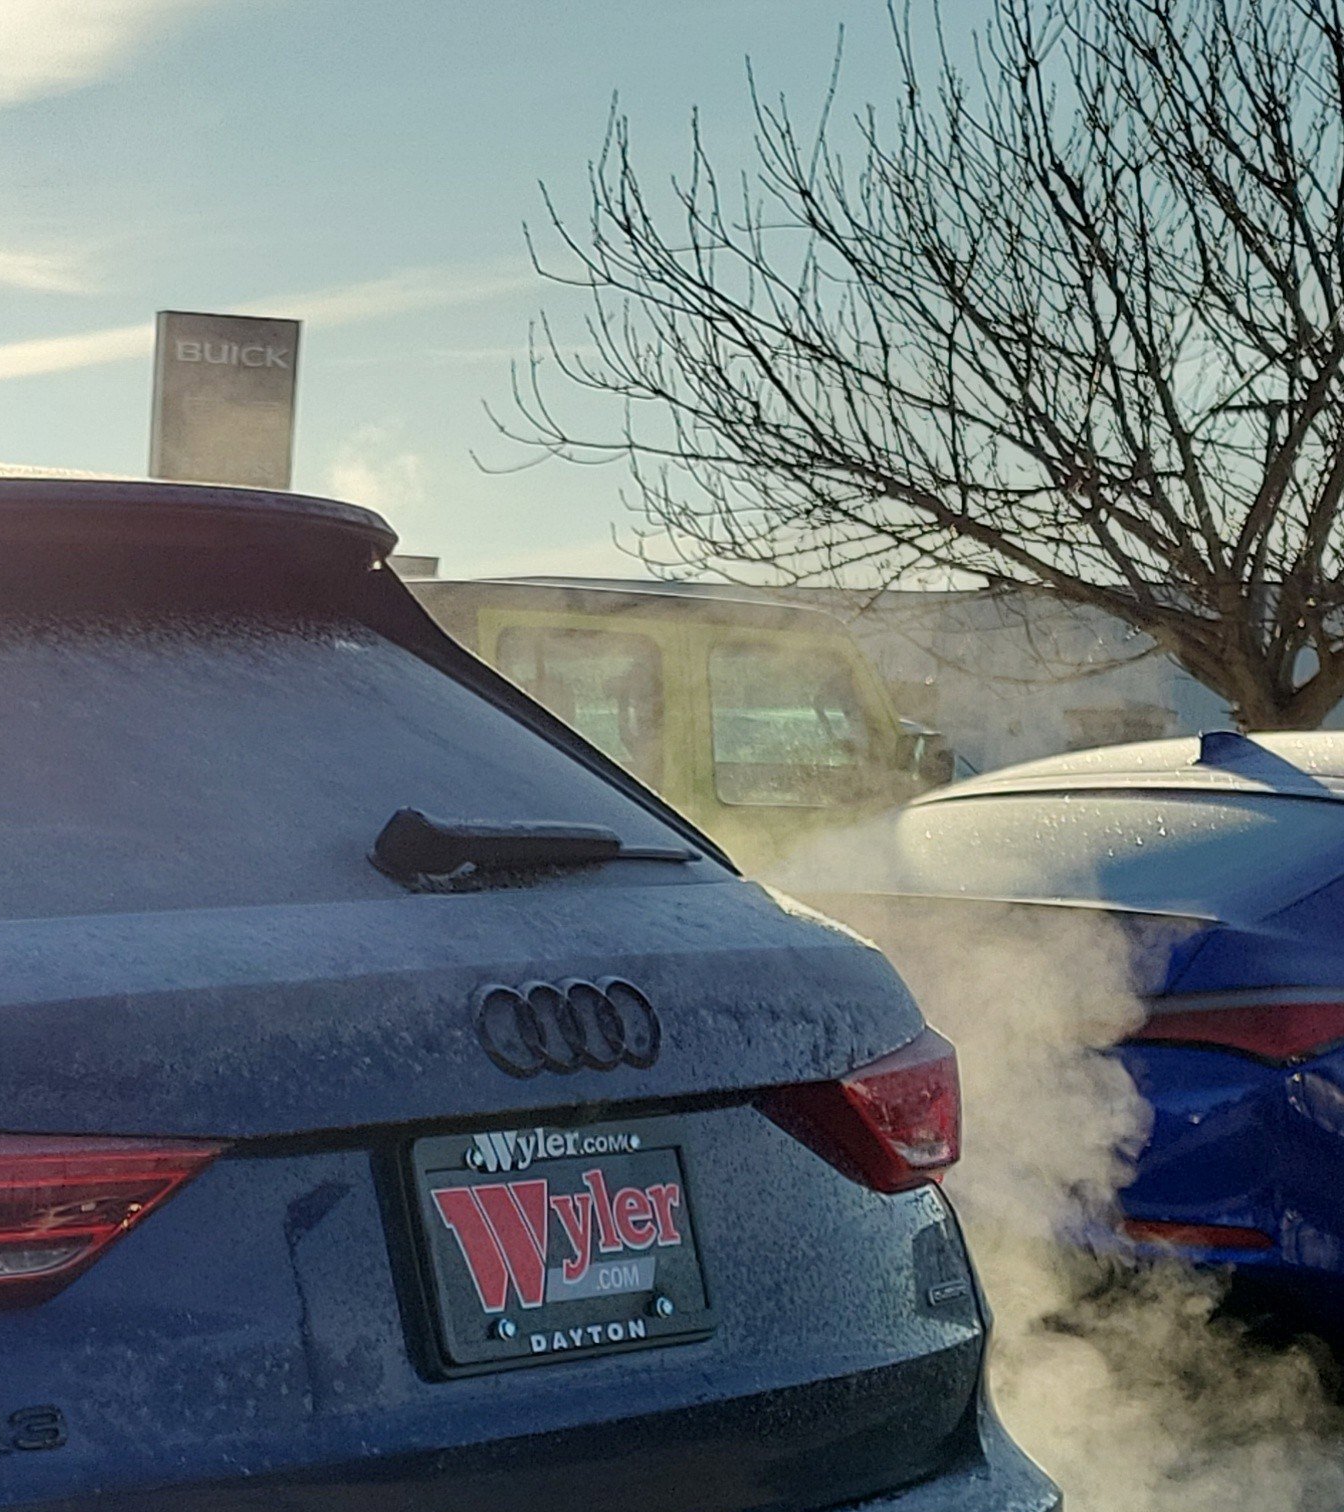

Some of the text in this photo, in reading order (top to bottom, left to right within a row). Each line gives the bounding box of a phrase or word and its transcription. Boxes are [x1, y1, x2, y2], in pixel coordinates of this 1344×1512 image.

[176, 341, 290, 369] BUICK
[431, 1169, 682, 1314] Wyler
[530, 1319, 647, 1353] DAYTON
